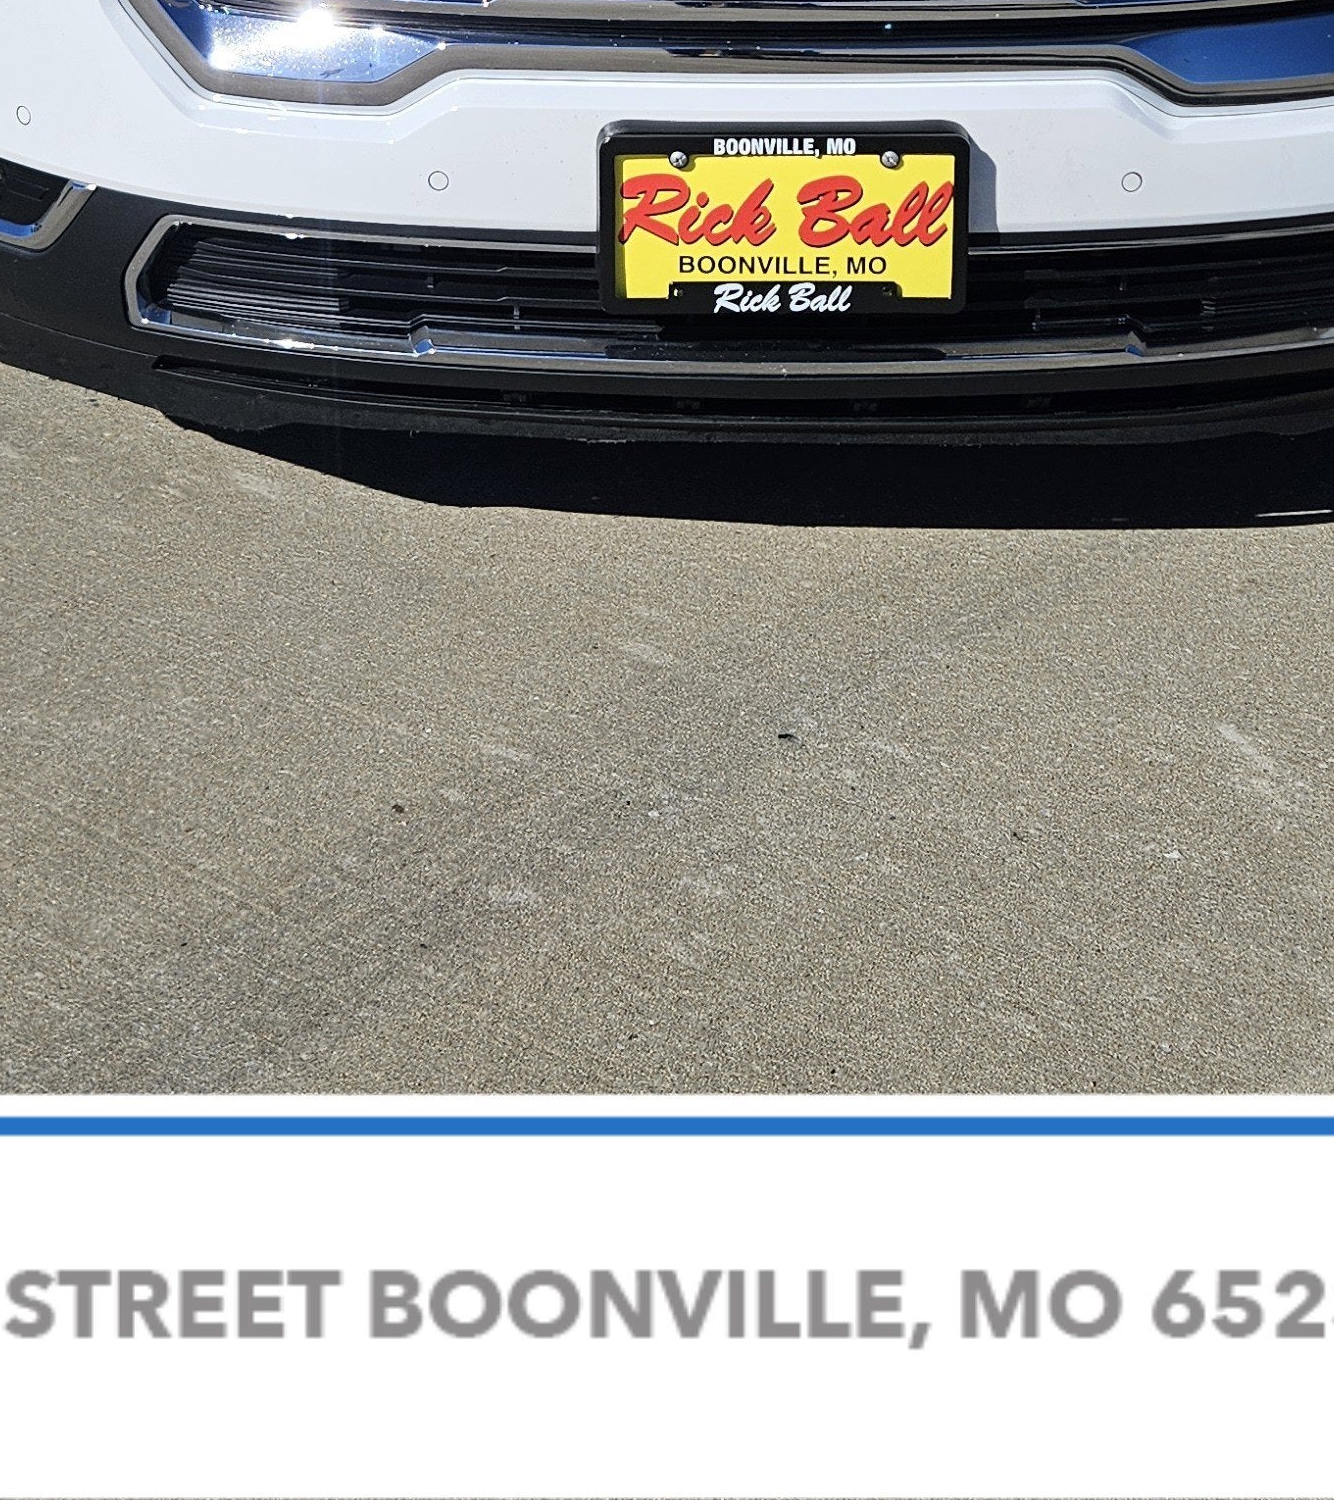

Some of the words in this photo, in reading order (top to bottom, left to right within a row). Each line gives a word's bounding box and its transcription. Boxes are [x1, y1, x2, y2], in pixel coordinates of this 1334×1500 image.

[713, 138, 820, 158] BOONVILLE,
[826, 138, 856, 155] MO
[619, 173, 777, 246] Rick
[796, 175, 955, 248] Ball
[679, 256, 838, 279] BOONVILLE,
[847, 257, 887, 275] MO
[713, 283, 782, 313] Rick
[788, 284, 854, 313] Ball
